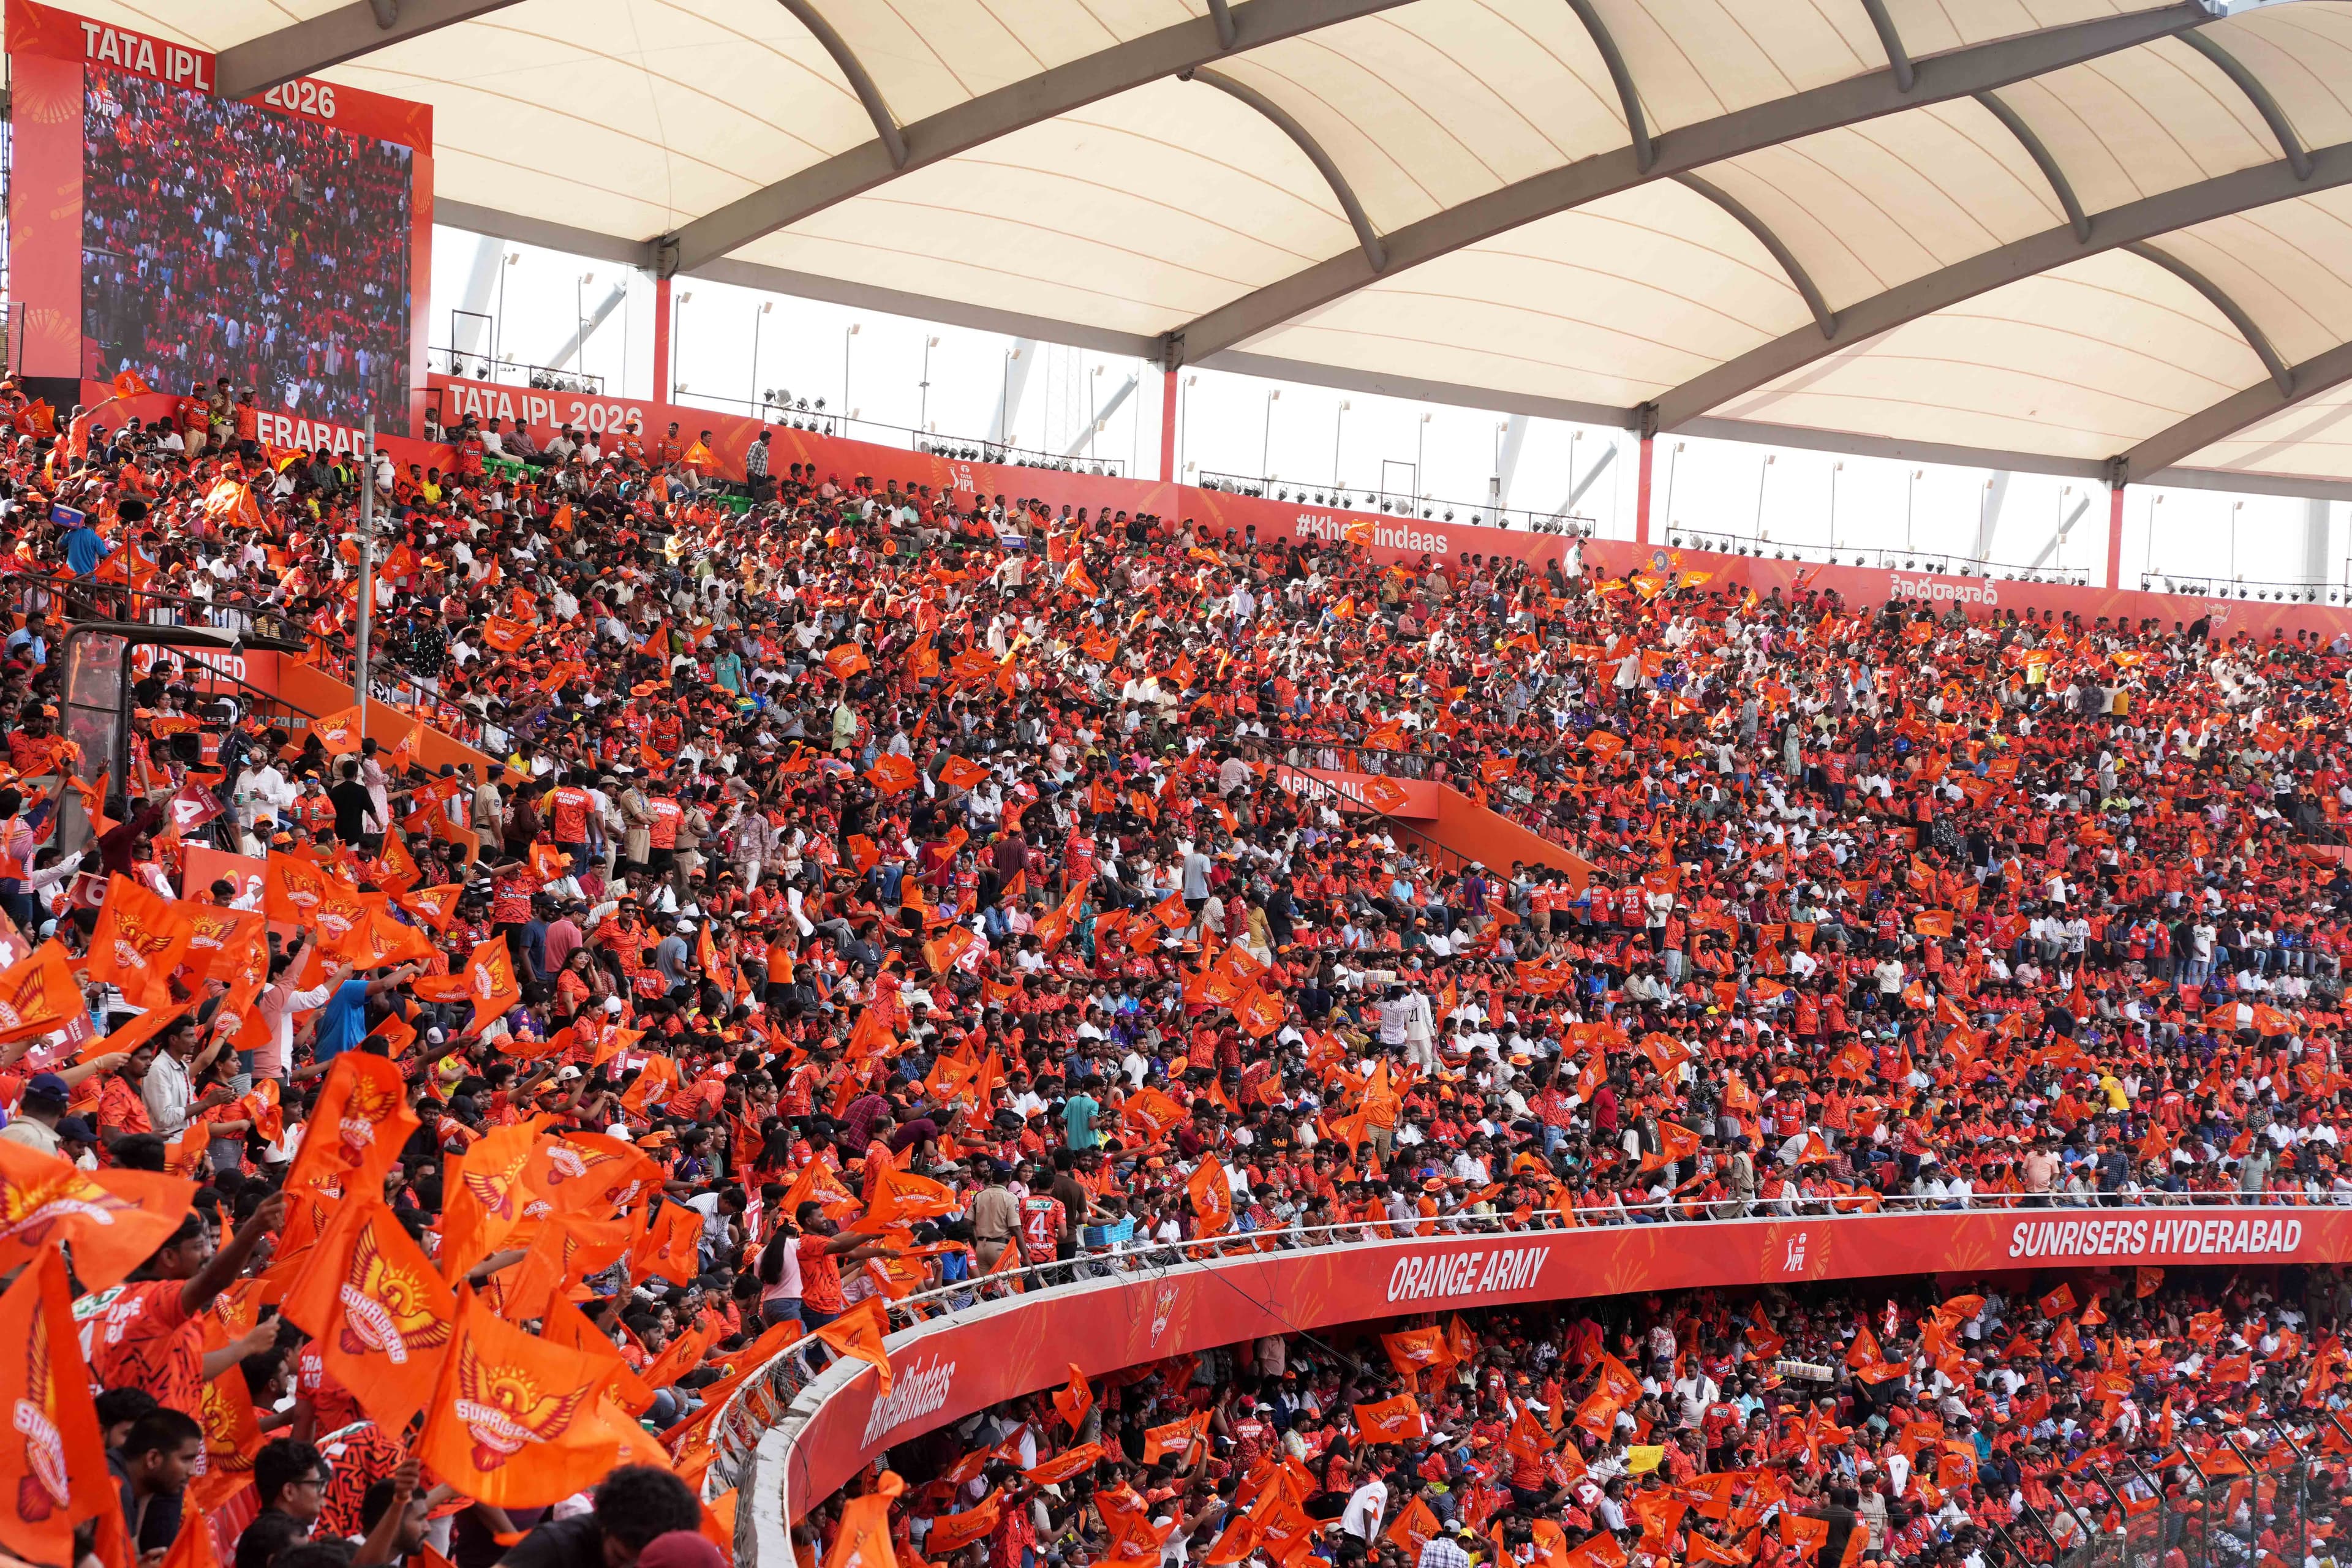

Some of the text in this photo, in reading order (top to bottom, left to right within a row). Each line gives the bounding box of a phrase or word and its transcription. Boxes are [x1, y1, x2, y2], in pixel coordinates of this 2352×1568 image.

[80, 21, 336, 118] TATA IPL 2026
[448, 384, 516, 423] TATA
[522, 395, 567, 429] IPL
[960, 479, 976, 493] IPL
[1295, 513, 1448, 554] #Kheindaas
[555, 791, 585, 802] ORANGE
[557, 797, 578, 805] ARMY
[173, 799, 204, 824] 4
[651, 802, 680, 812] ORANGE
[1624, 896, 1640, 909] 23
[962, 949, 979, 969] 4
[1409, 1007, 1419, 1022] 21
[72, 1017, 83, 1040] Shree
[1027, 1201, 1052, 1210] BKT
[749, 1213, 758, 1241] 4
[1028, 1212, 1048, 1242] 4
[2009, 1219, 2302, 1257] SUNRISERS HYDERABAD
[1789, 1253, 1804, 1272] IPL
[1387, 1246, 1550, 1302] ORANGE ARMY
[340, 1284, 407, 1363] SUNRISERS
[1886, 1316, 1894, 1334] 4
[1578, 1484, 1599, 1504] 4
